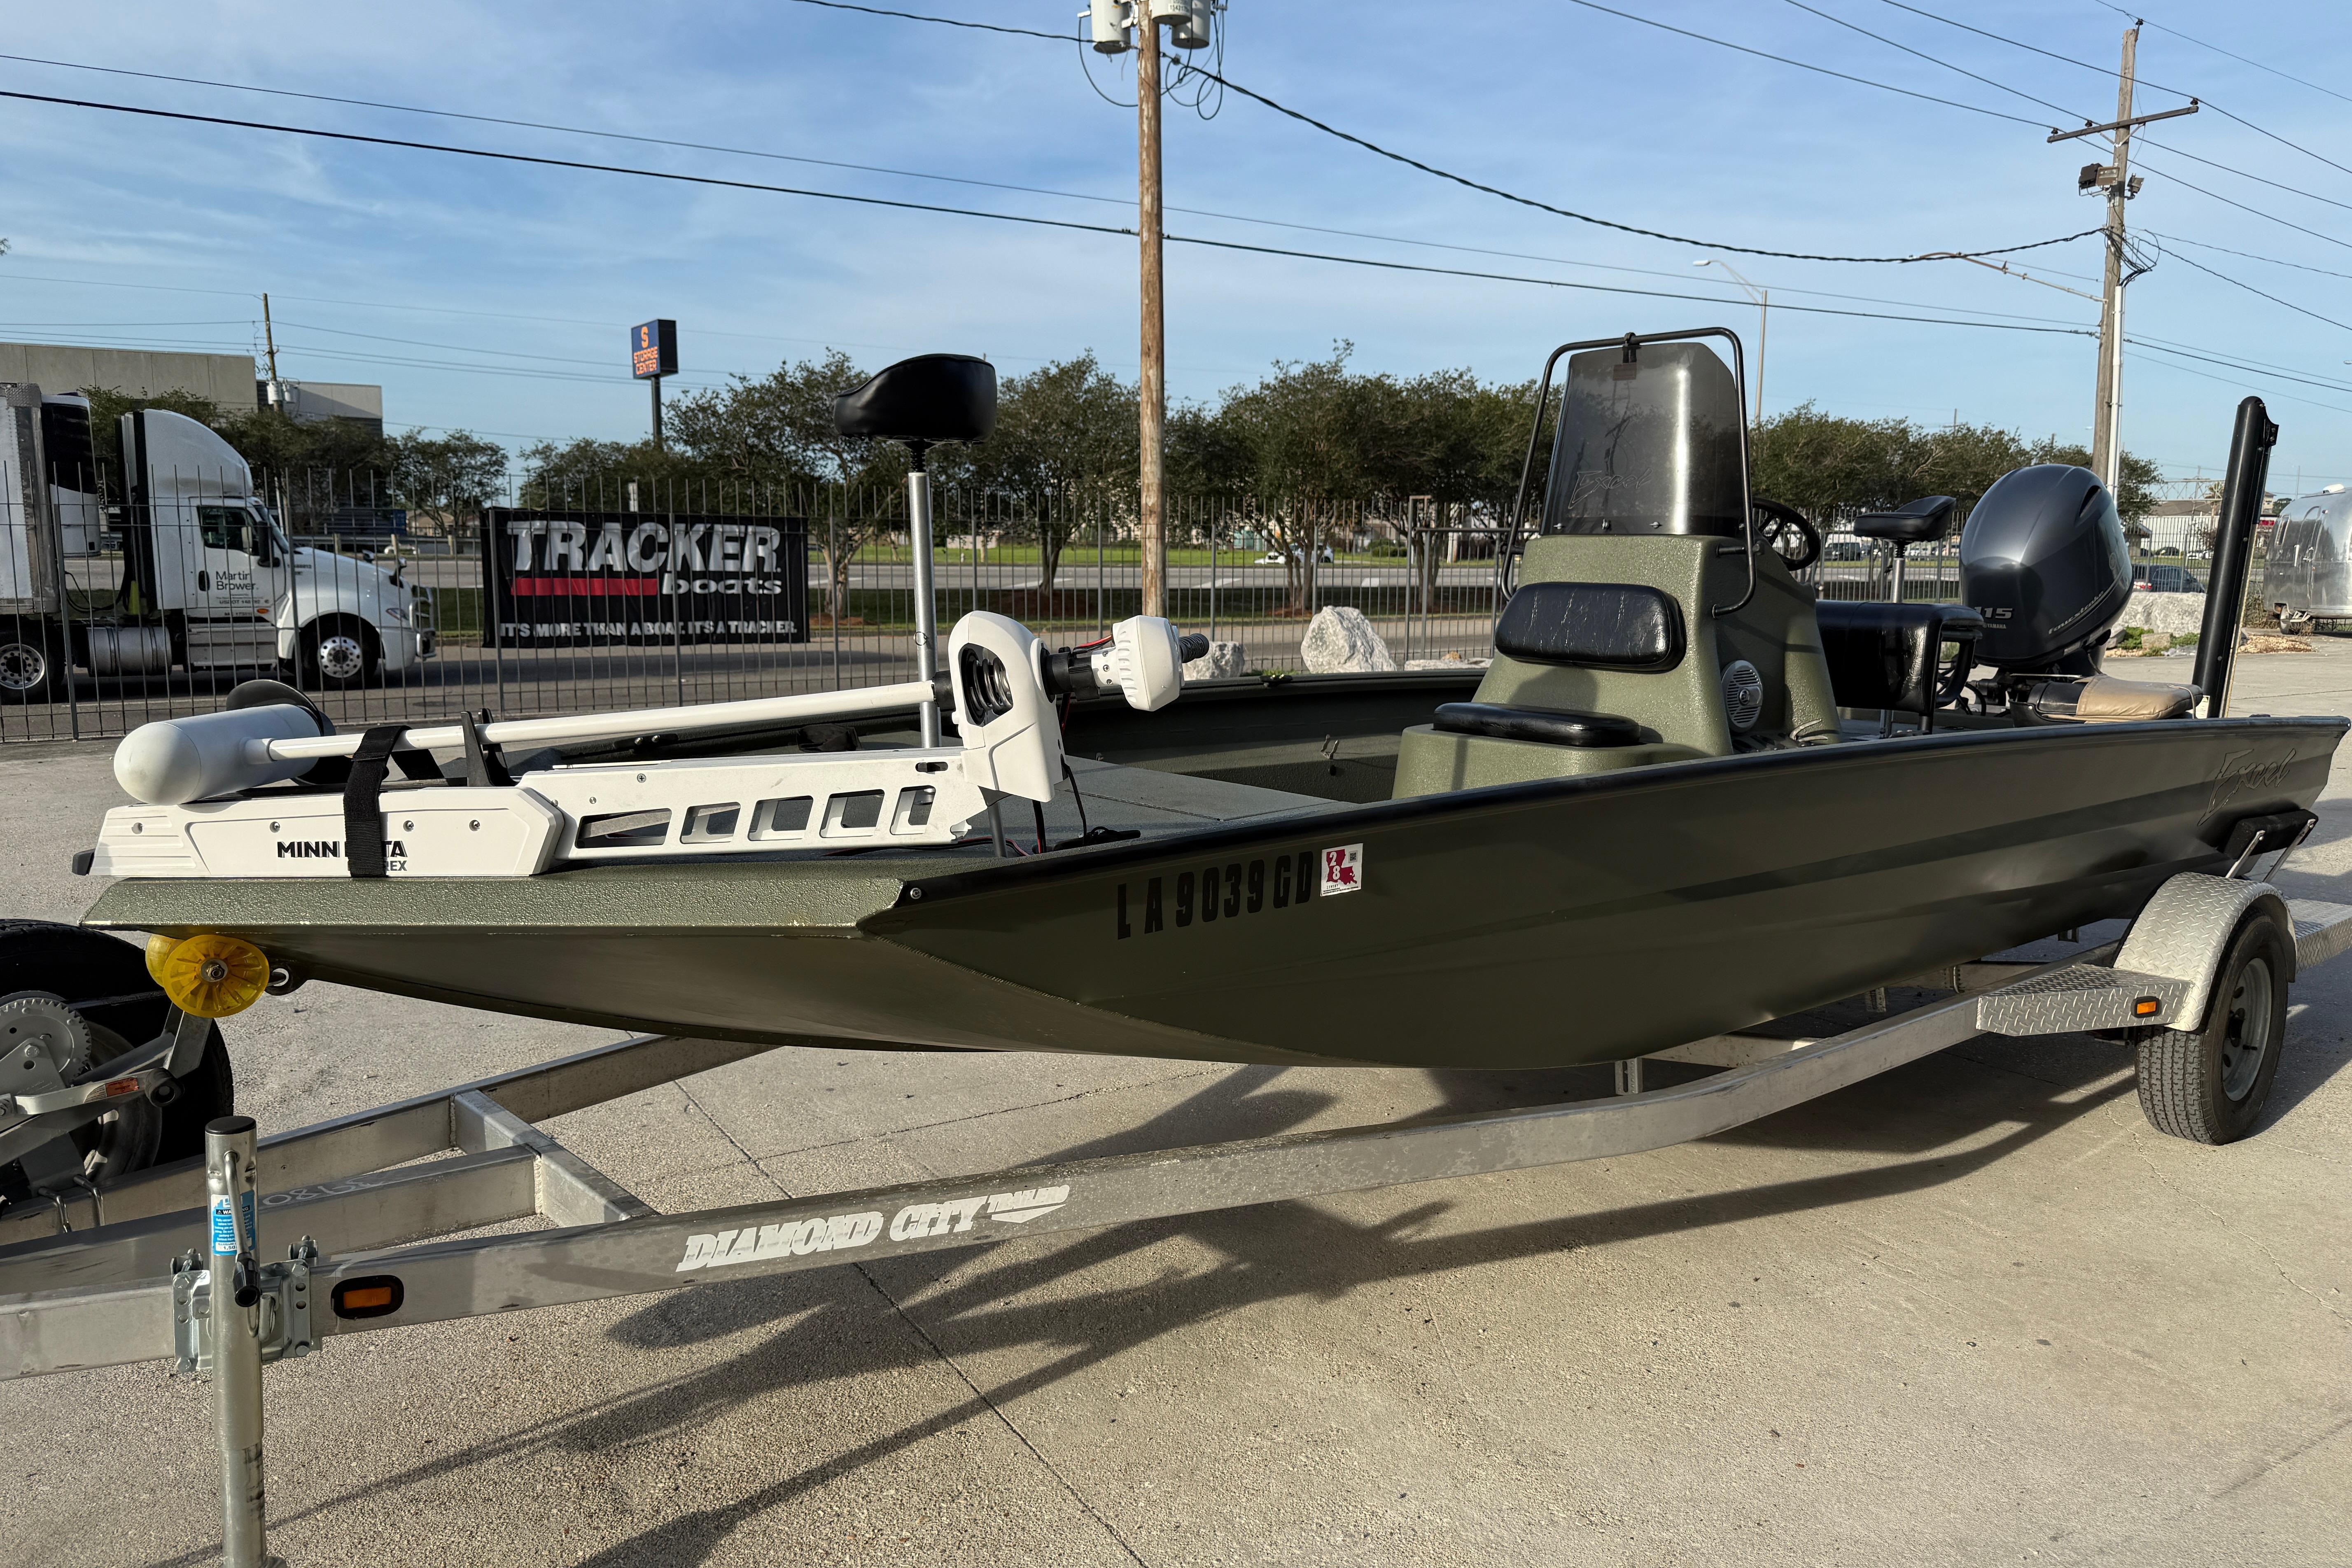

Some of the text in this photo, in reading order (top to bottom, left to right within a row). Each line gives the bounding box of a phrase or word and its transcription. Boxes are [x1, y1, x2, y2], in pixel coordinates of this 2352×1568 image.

[641, 326, 649, 348] S
[634, 346, 658, 364] STORAGE
[636, 359, 657, 375] CENTER
[1568, 468, 1653, 509] Excel
[507, 520, 781, 573] TRACKER
[663, 573, 782, 595] boats
[1974, 607, 2013, 618] 115
[500, 623, 530, 637] IT'S
[533, 622, 581, 637] MORE
[583, 622, 626, 636] THAN
[630, 622, 642, 636] A
[688, 621, 714, 635] IT'S
[716, 621, 726, 634] A
[728, 621, 797, 634] TRACKER.
[2197, 748, 2296, 826] Excel
[277, 841, 340, 858] MINN
[1118, 851, 1314, 940] LA 9039 GD
[676, 1211, 884, 1272] DIAMOND
[889, 1195, 989, 1242] CITY
